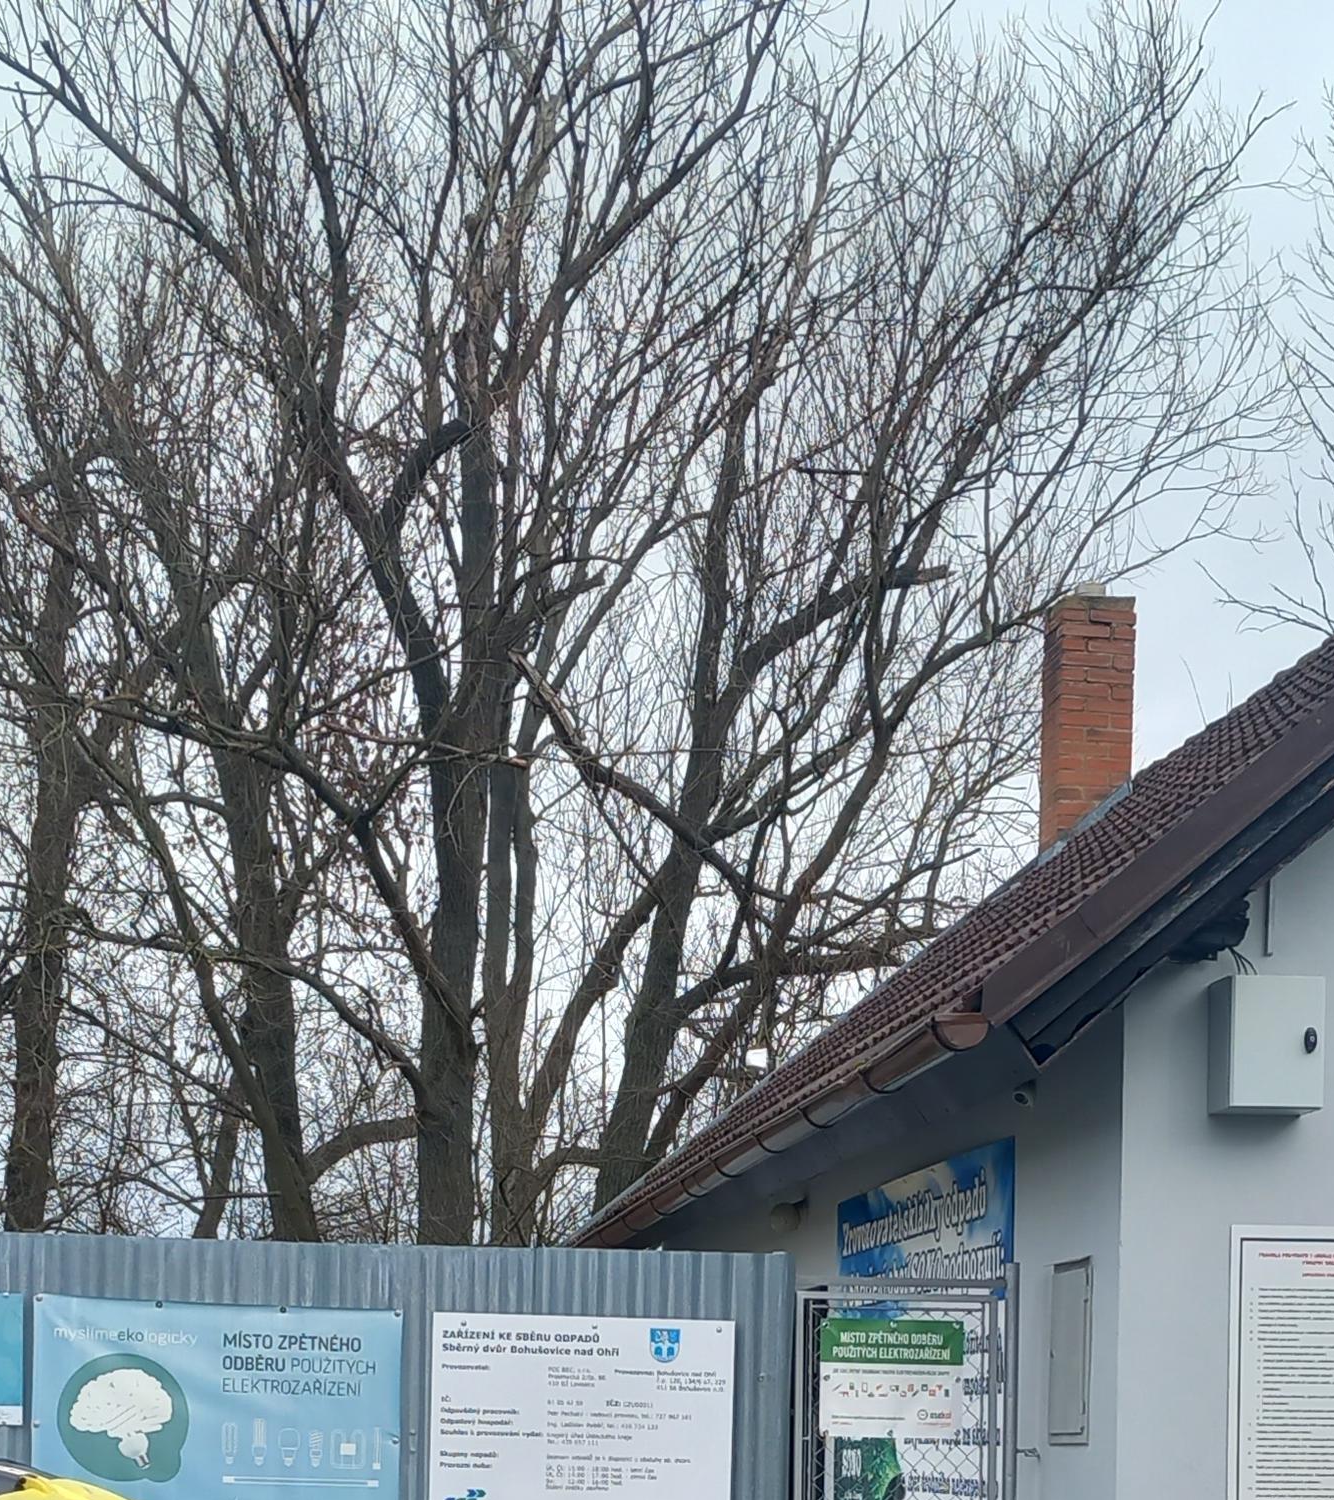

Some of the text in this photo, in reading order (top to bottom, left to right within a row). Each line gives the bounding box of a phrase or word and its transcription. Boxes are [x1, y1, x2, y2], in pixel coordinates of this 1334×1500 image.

[223, 1331, 362, 1353] MÍSTO ZPĚTNÉHO
[442, 1328, 600, 1343] ZAŘÍZENÍ KE SBĚRU ODPADŮ
[840, 1330, 944, 1345] MÍSTO ZPĚTNÉHO ODBĚRU
[442, 1343, 619, 1357] Sběrný dvůr Bohušovice nad Ohří
[832, 1345, 950, 1361] POUŽITÝCH ELEKTROZAŘÍZENÍ
[222, 1354, 286, 1372] ODBĚRU
[222, 1377, 362, 1397] ELEKTROZAŘÍZENÍ
